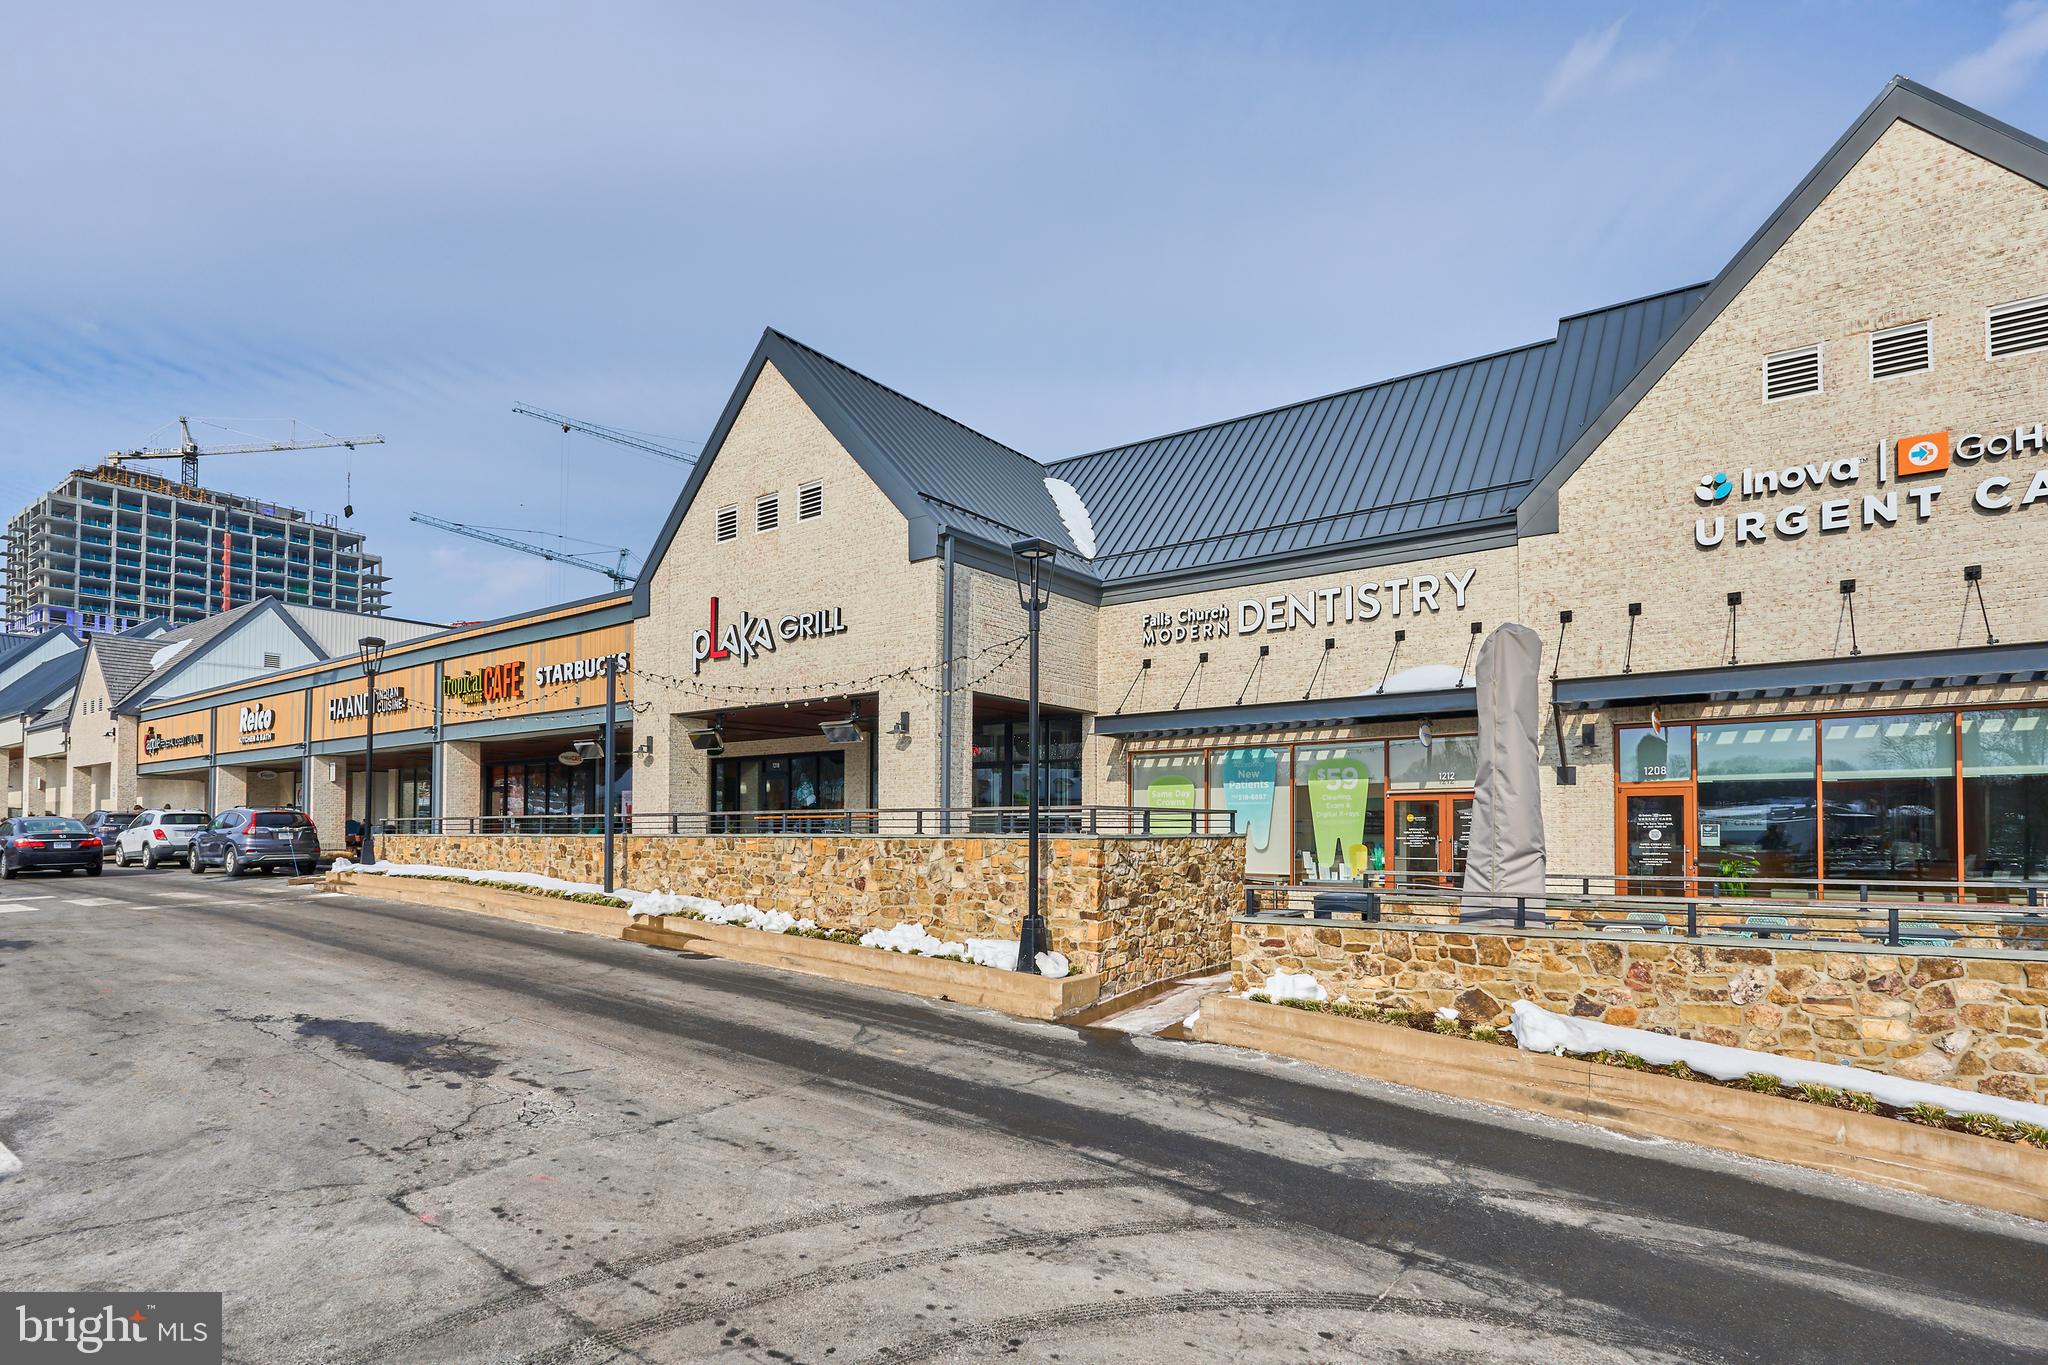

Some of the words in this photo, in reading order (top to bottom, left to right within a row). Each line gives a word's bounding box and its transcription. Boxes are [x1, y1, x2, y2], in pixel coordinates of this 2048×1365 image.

[1742, 457, 1859, 495] Inova
[1956, 423, 2048, 460] GoH
[1695, 485, 1942, 546] URGENT
[1142, 612, 1172, 628] Falls
[1178, 604, 1229, 623] Church
[1238, 568, 1476, 634] DENTISTRY
[778, 607, 845, 640] GRILL
[1142, 621, 1230, 646] MODERN
[442, 669, 484, 699] tropical
[484, 661, 521, 701] CAFE
[536, 653, 627, 686] STARBUCS
[240, 703, 272, 732] Reico
[377, 698, 403, 713] CUISINE
[1238, 769, 1260, 779] New
[1438, 772, 1455, 780] 1212
[1643, 766, 1667, 775] 1208
[1152, 790, 1173, 798] Same
[1175, 789, 1190, 799] Day
[1229, 780, 1270, 790] Patients
